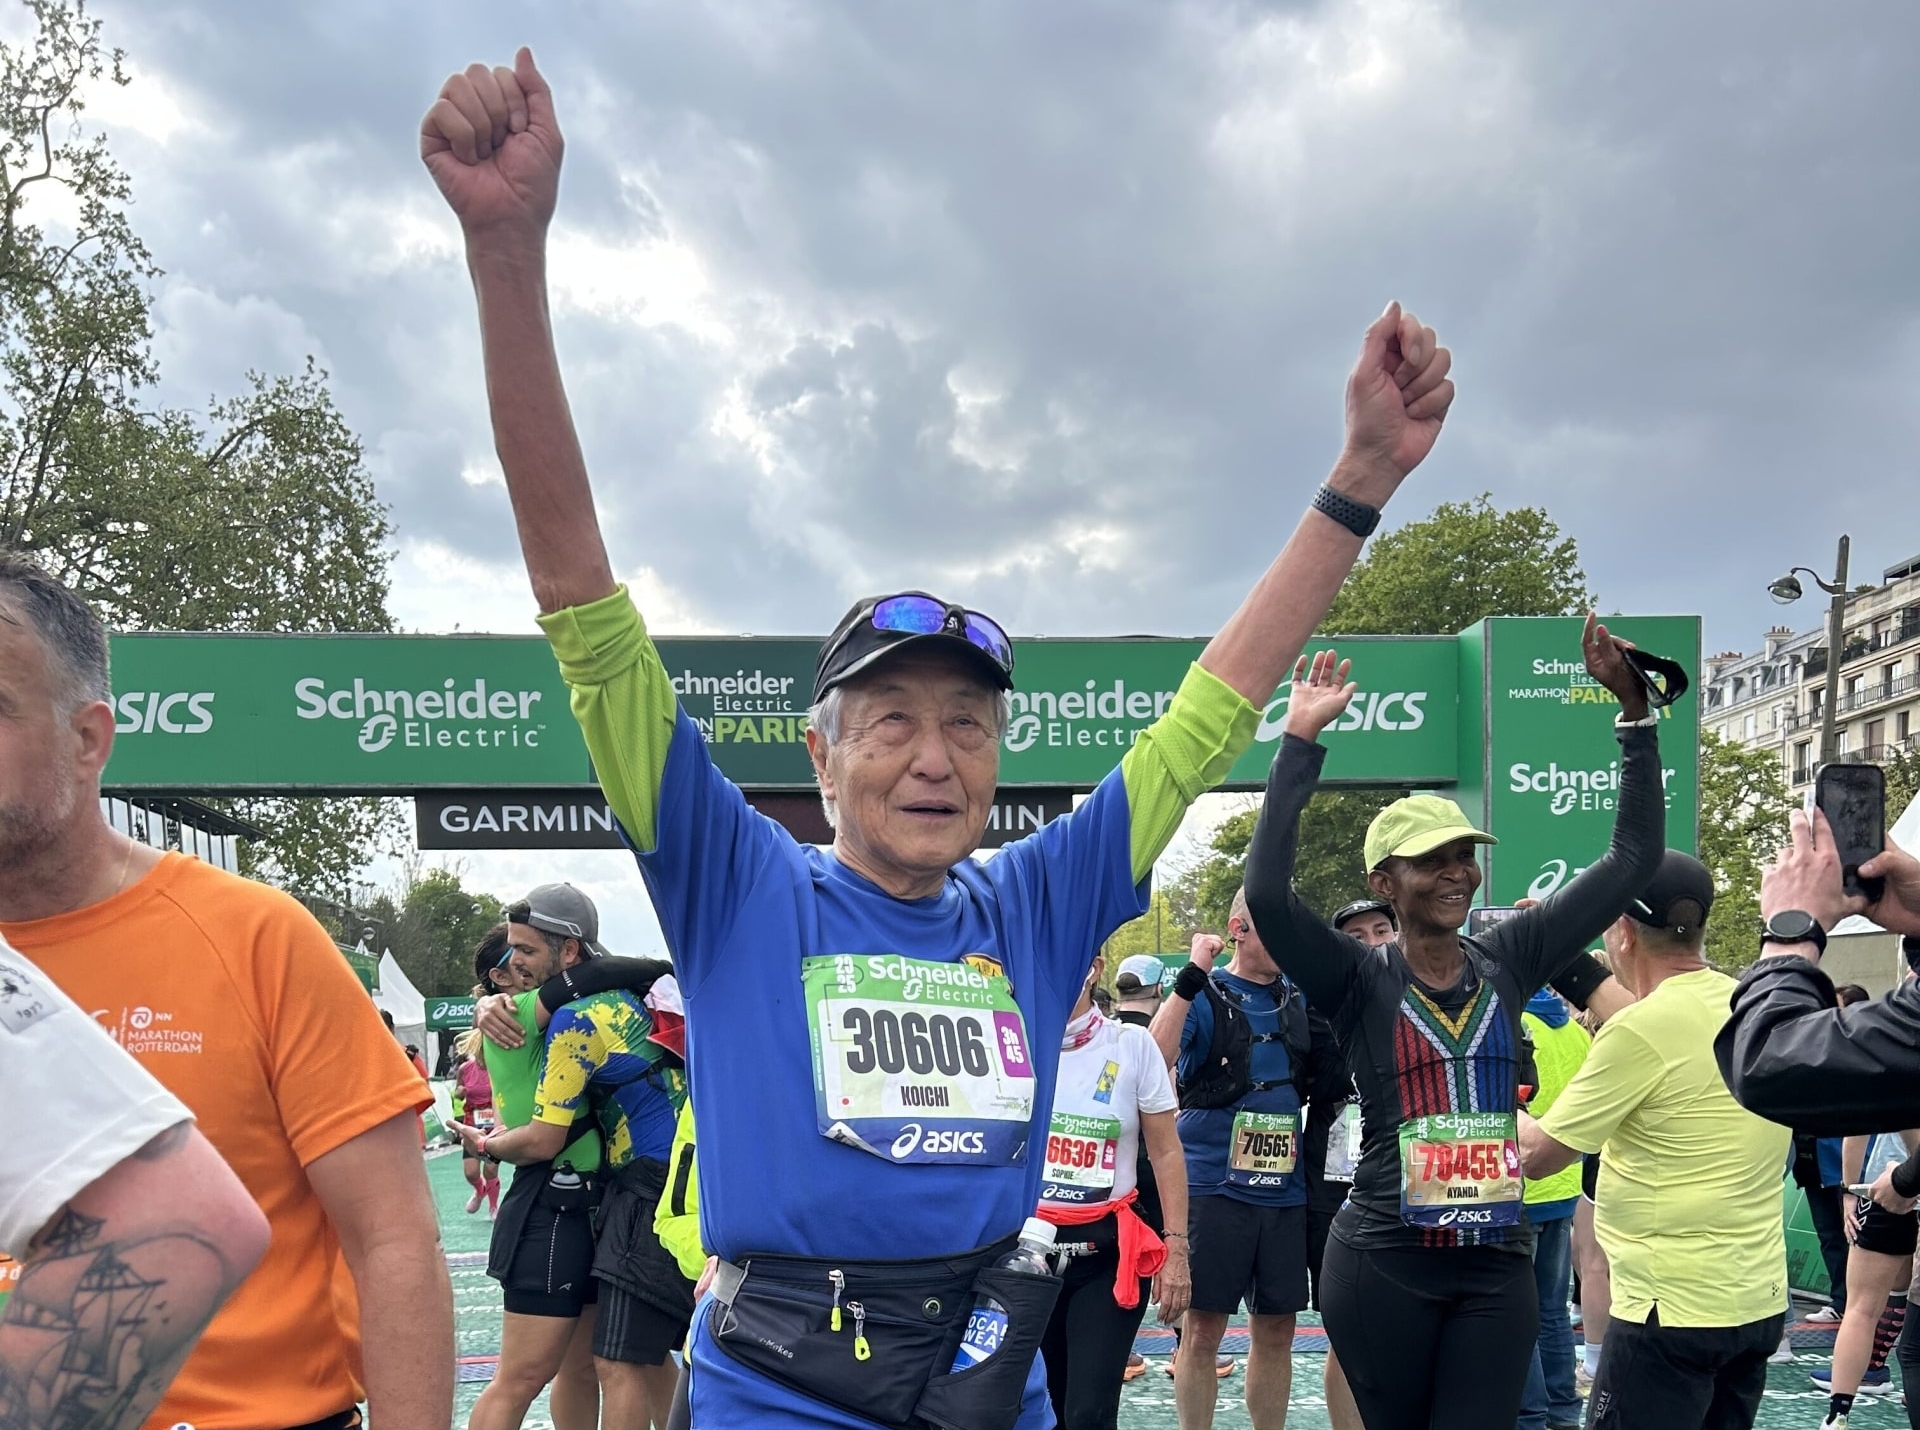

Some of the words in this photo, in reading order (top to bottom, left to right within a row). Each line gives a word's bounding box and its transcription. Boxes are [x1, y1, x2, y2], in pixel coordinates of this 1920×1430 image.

[1532, 658, 1587, 675] Schne
[670, 669, 794, 695] chneider
[294, 677, 542, 719] Schneider
[713, 695, 792, 711] Electric
[1004, 679, 1178, 719] hneider
[1509, 687, 1570, 699] MARATHON
[1571, 687, 1620, 704] PAR
[112, 691, 215, 734] SICS
[1322, 691, 1428, 731] SICS
[404, 723, 539, 748] Electric
[1048, 722, 1140, 746] Electr
[1509, 760, 1676, 793] Schneir
[439, 804, 612, 832] GARMIN
[867, 957, 989, 990] Schneider
[926, 984, 994, 1005] Electric
[155, 1012, 173, 1021] NN
[448, 1004, 475, 1016] asic
[127, 1029, 203, 1042] MARATHON
[843, 1007, 990, 1077] 30606
[127, 1041, 203, 1054] ROTTERDAM
[1006, 1045, 1025, 1064] 45
[900, 1086, 950, 1107] KOICHI
[1051, 1112, 1111, 1131] Schneider
[1435, 1114, 1507, 1129] Schneider
[1470, 1127, 1506, 1137] Electric
[1047, 1135, 1098, 1168] 6636
[1242, 1131, 1290, 1158] 70565
[1447, 1186, 1479, 1199] AYANDA
[963, 1328, 998, 1350] WEA
